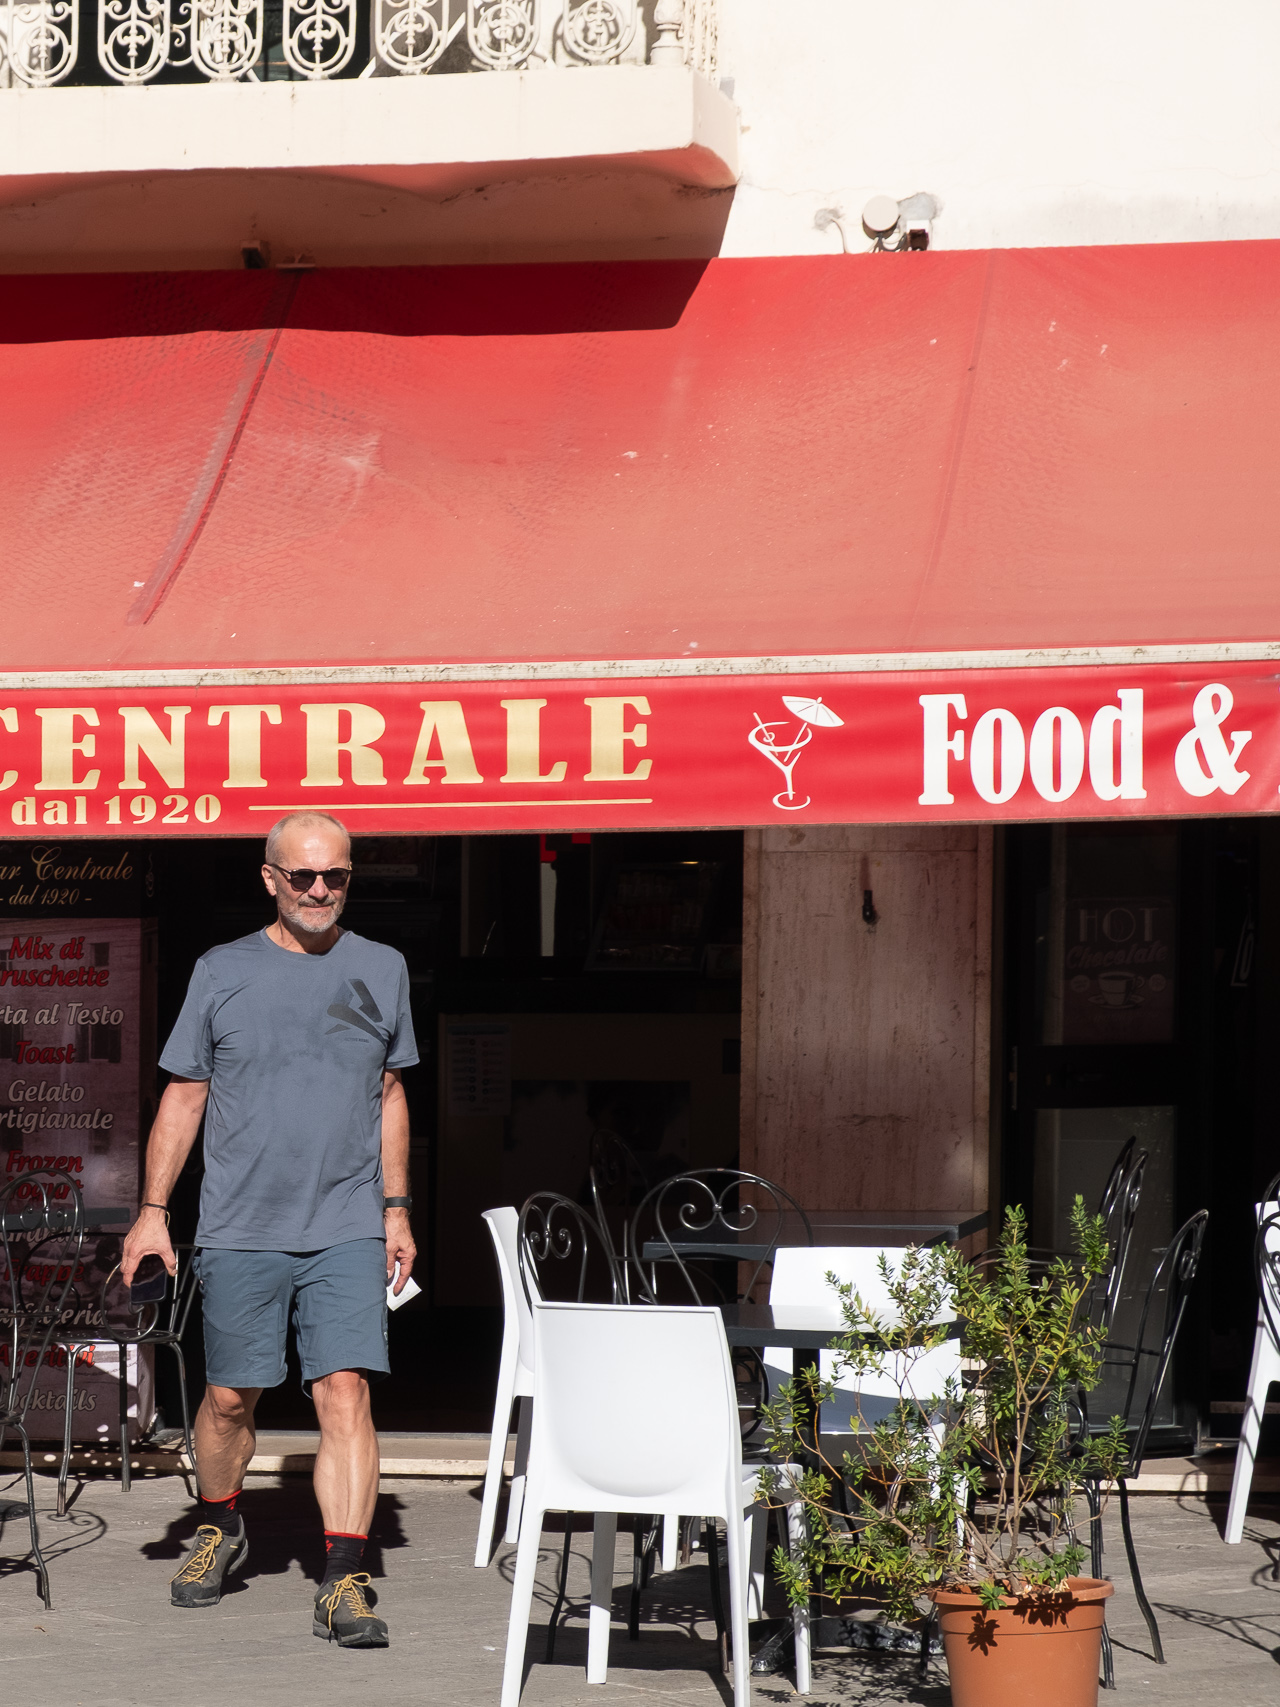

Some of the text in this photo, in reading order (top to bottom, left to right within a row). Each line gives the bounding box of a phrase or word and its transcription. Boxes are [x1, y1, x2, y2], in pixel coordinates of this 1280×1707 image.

[918, 688, 1147, 805] Food
[1175, 683, 1252, 797] &
[11, 793, 221, 826] dal 1920
[31, 845, 133, 882] Centrale
[9, 884, 40, 905] dal
[41, 888, 80, 905] 1920
[1079, 907, 1159, 943] HOT
[8, 936, 86, 960] Mix di
[1065, 940, 1169, 969] Chocolate
[34, 1003, 60, 1025] al
[67, 1002, 124, 1025] Testo
[15, 1040, 76, 1065] Toast
[8, 1079, 85, 1103] Gelato
[5, 1150, 84, 1177] Frozen
